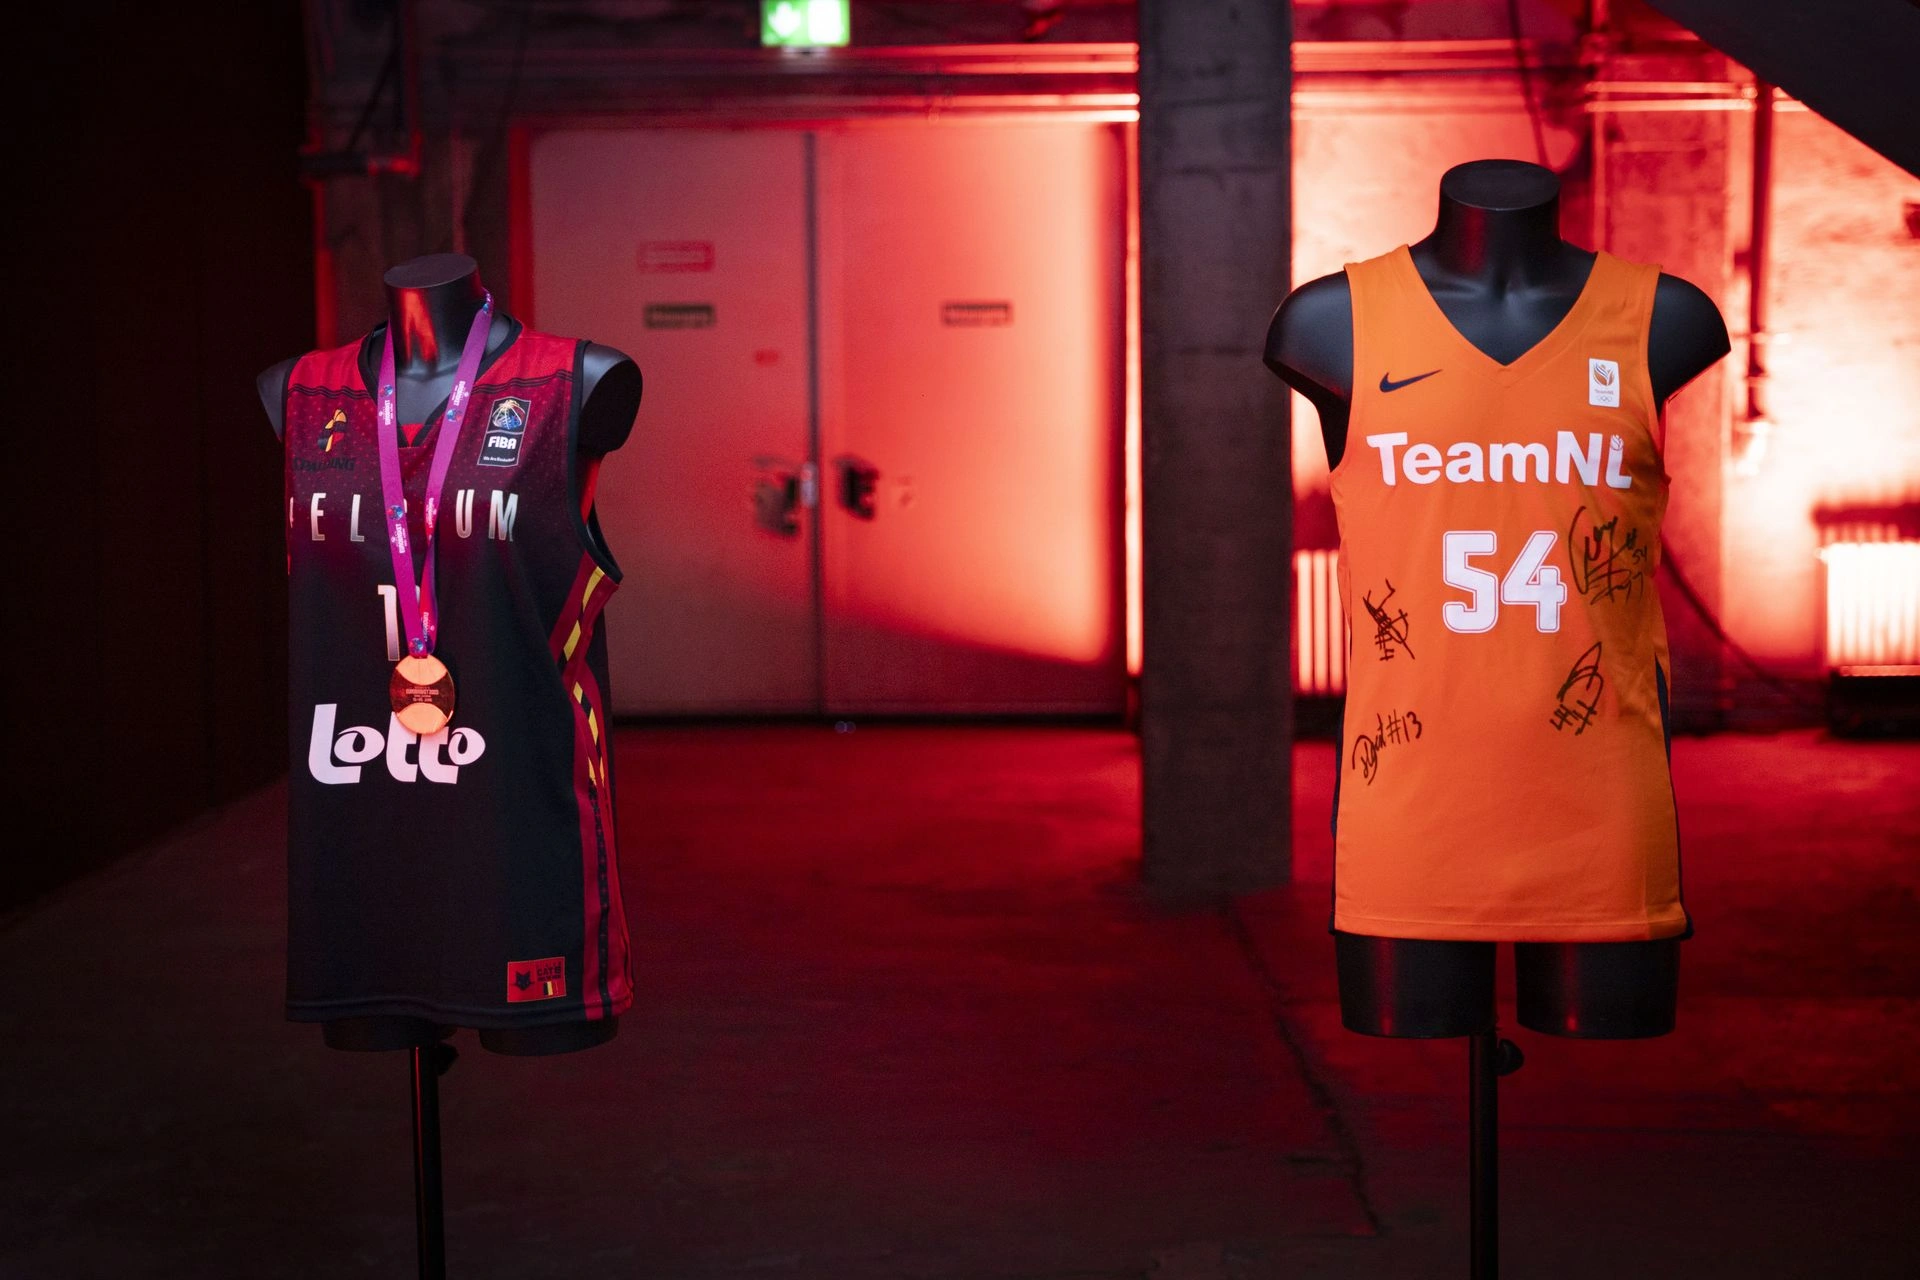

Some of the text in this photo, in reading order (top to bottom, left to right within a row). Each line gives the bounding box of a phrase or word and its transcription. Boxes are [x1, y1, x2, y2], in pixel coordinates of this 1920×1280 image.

[488, 435, 517, 450] FIBA
[1366, 430, 1632, 489] TeamNL
[290, 489, 518, 542] ELUM
[1443, 530, 1567, 633] 54
[308, 703, 486, 785] Lotto
